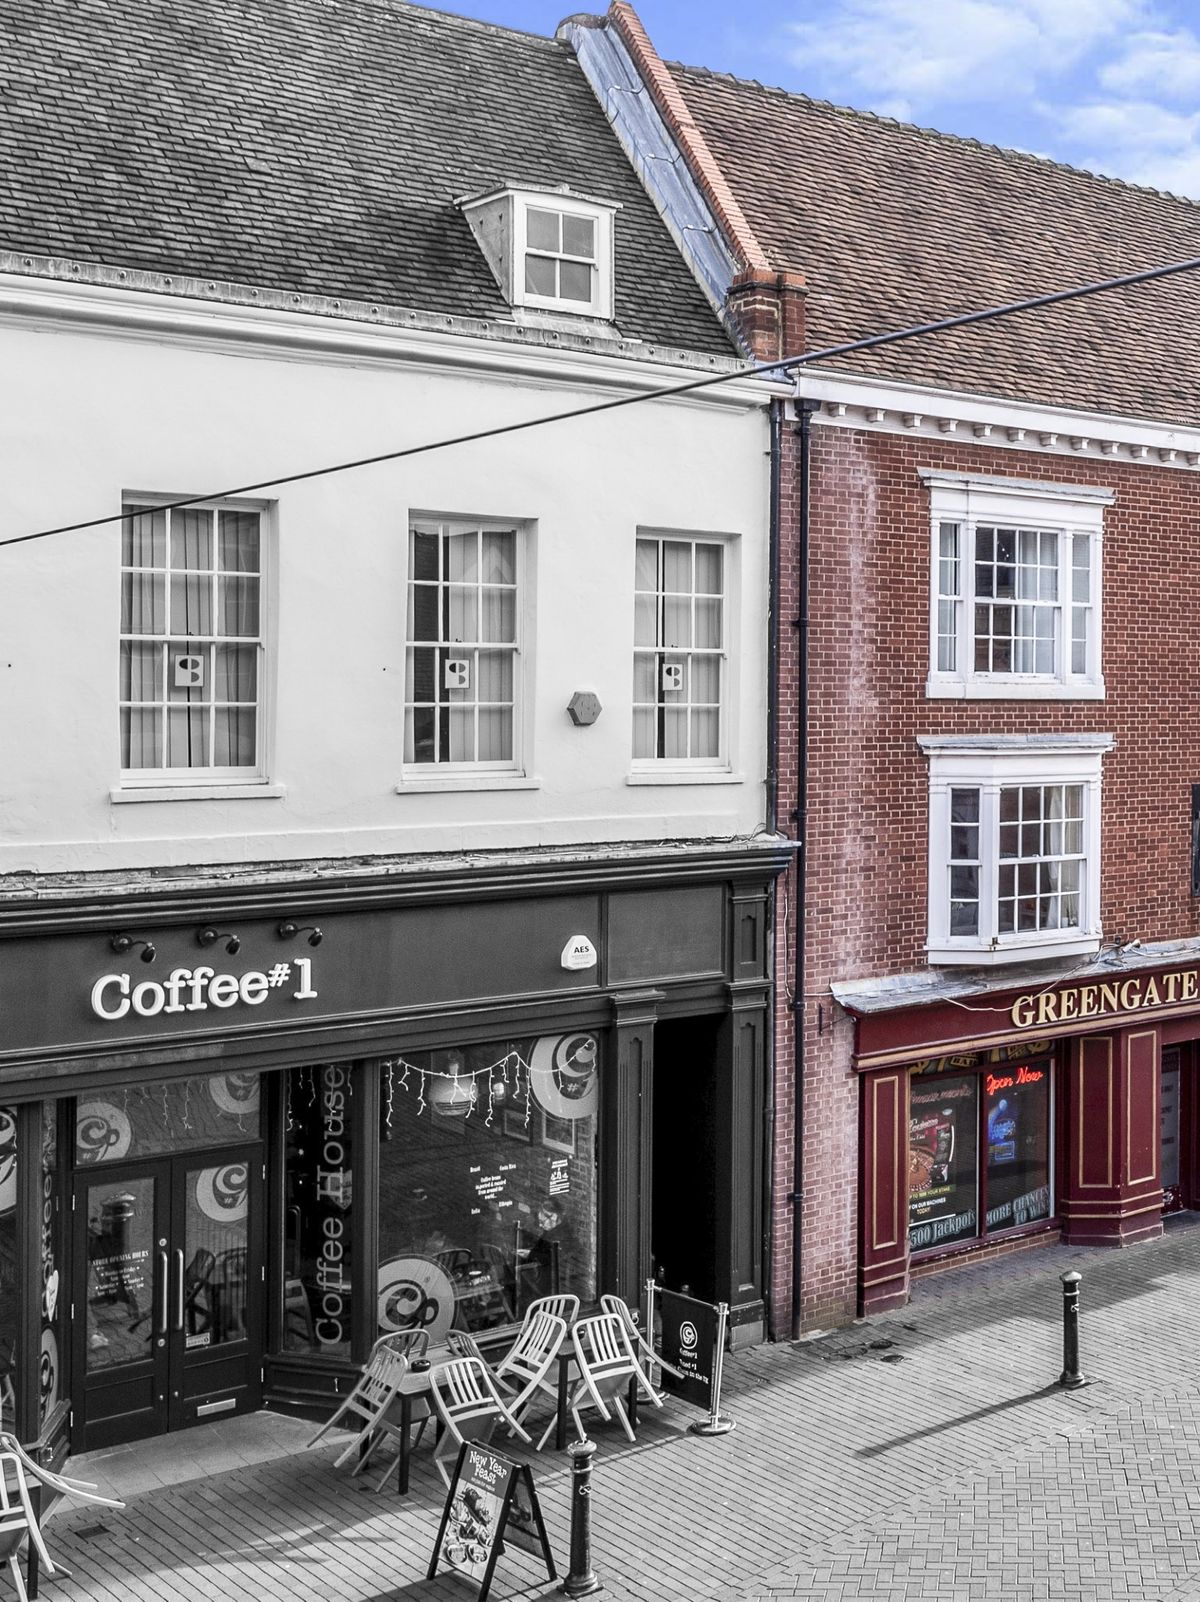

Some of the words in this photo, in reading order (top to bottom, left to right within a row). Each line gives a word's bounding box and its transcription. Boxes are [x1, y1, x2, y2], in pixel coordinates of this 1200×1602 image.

[574, 946, 590, 954] AES
[91, 957, 318, 1020] Coffee#1
[1011, 969, 1199, 1028] GREENGATE
[1016, 1066, 1044, 1084] Now
[316, 1064, 344, 1203] House
[986, 1201, 1012, 1226] MORE
[1014, 1210, 1027, 1226] TO
[910, 1226, 930, 1246] 500
[315, 1216, 344, 1345] Coffee
[470, 1450, 488, 1466] New
[489, 1456, 508, 1478] Year
[474, 1462, 496, 1485] Feast
